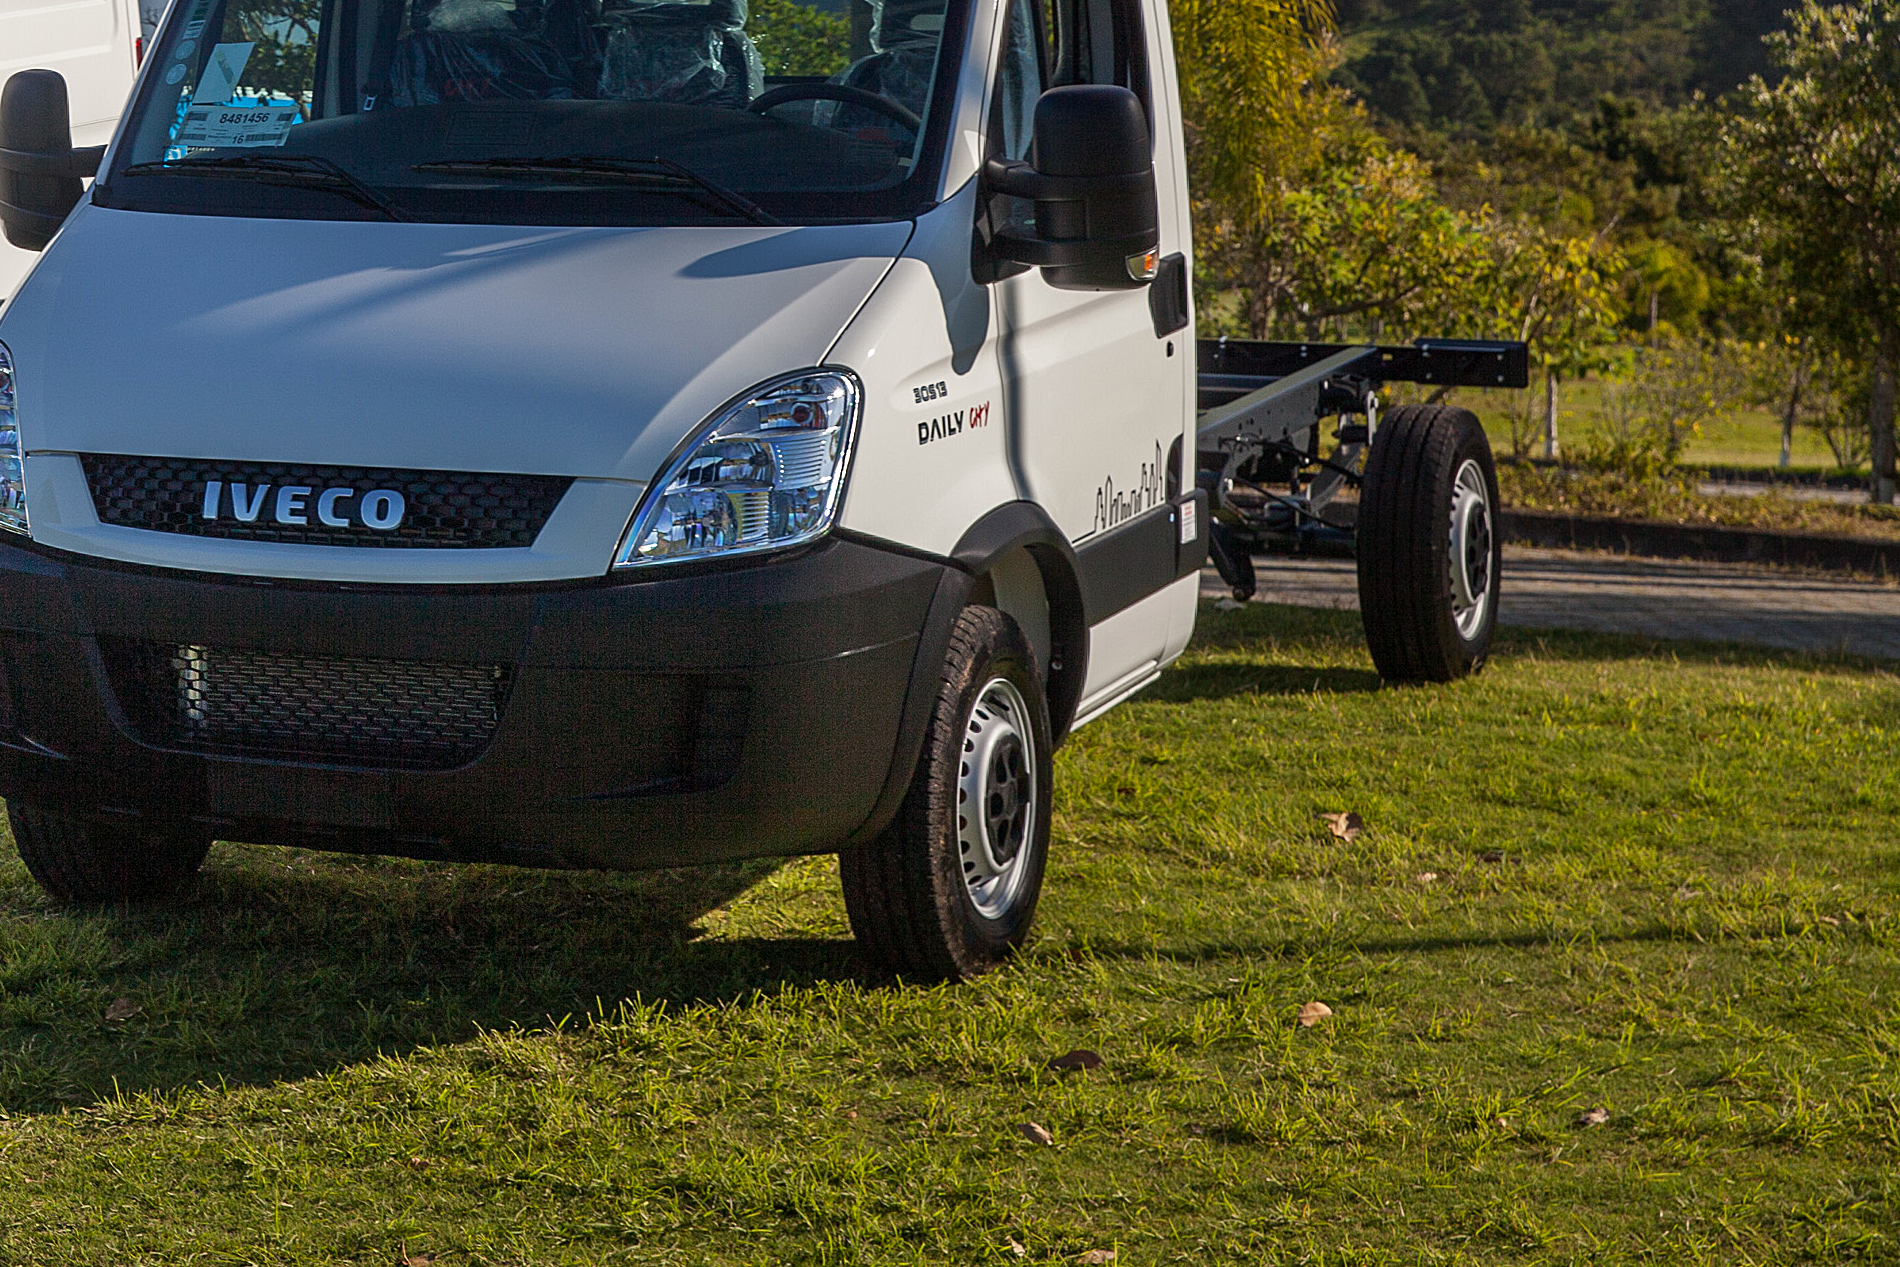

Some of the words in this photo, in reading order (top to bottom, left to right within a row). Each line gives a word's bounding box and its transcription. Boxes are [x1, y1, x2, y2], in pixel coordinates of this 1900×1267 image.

[219, 112, 271, 125] 8481456
[231, 135, 245, 145] 16
[917, 410, 964, 445] DAILY
[969, 400, 990, 429] CITY
[201, 480, 406, 530] IVECO
